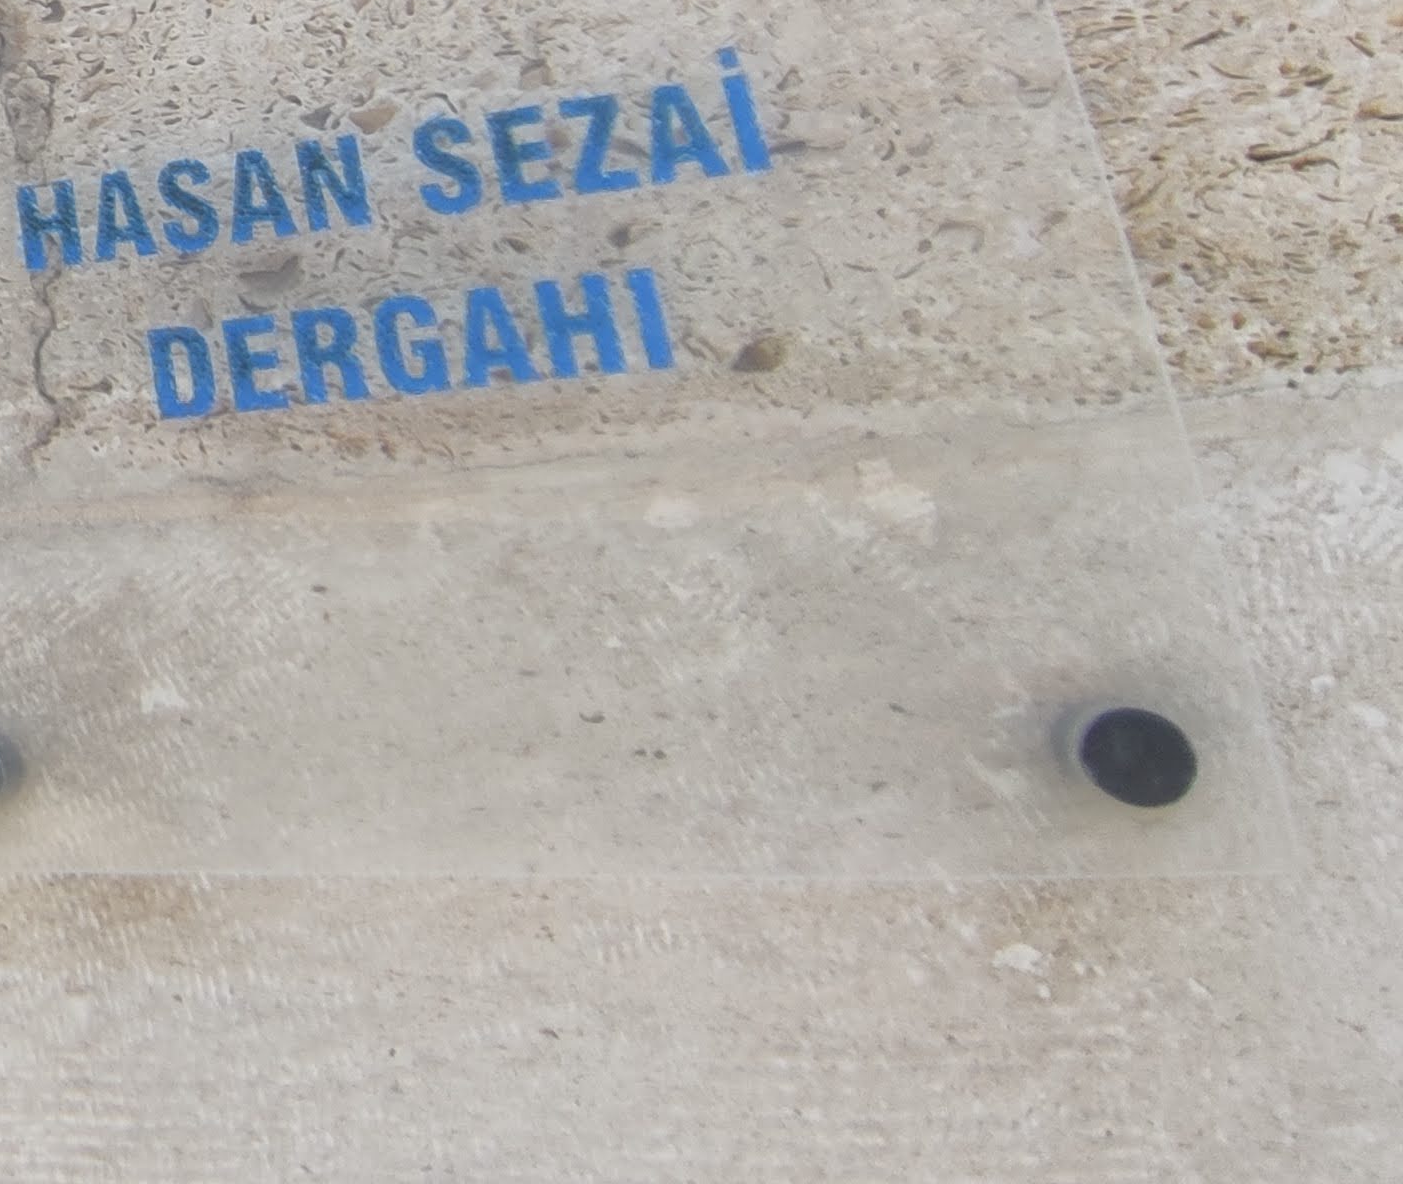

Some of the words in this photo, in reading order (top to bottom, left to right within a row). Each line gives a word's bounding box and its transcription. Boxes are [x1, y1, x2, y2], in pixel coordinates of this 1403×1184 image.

[17, 134, 372, 271] HASAN
[412, 46, 772, 215] SEZAİ
[147, 268, 676, 420] DERGAHI
